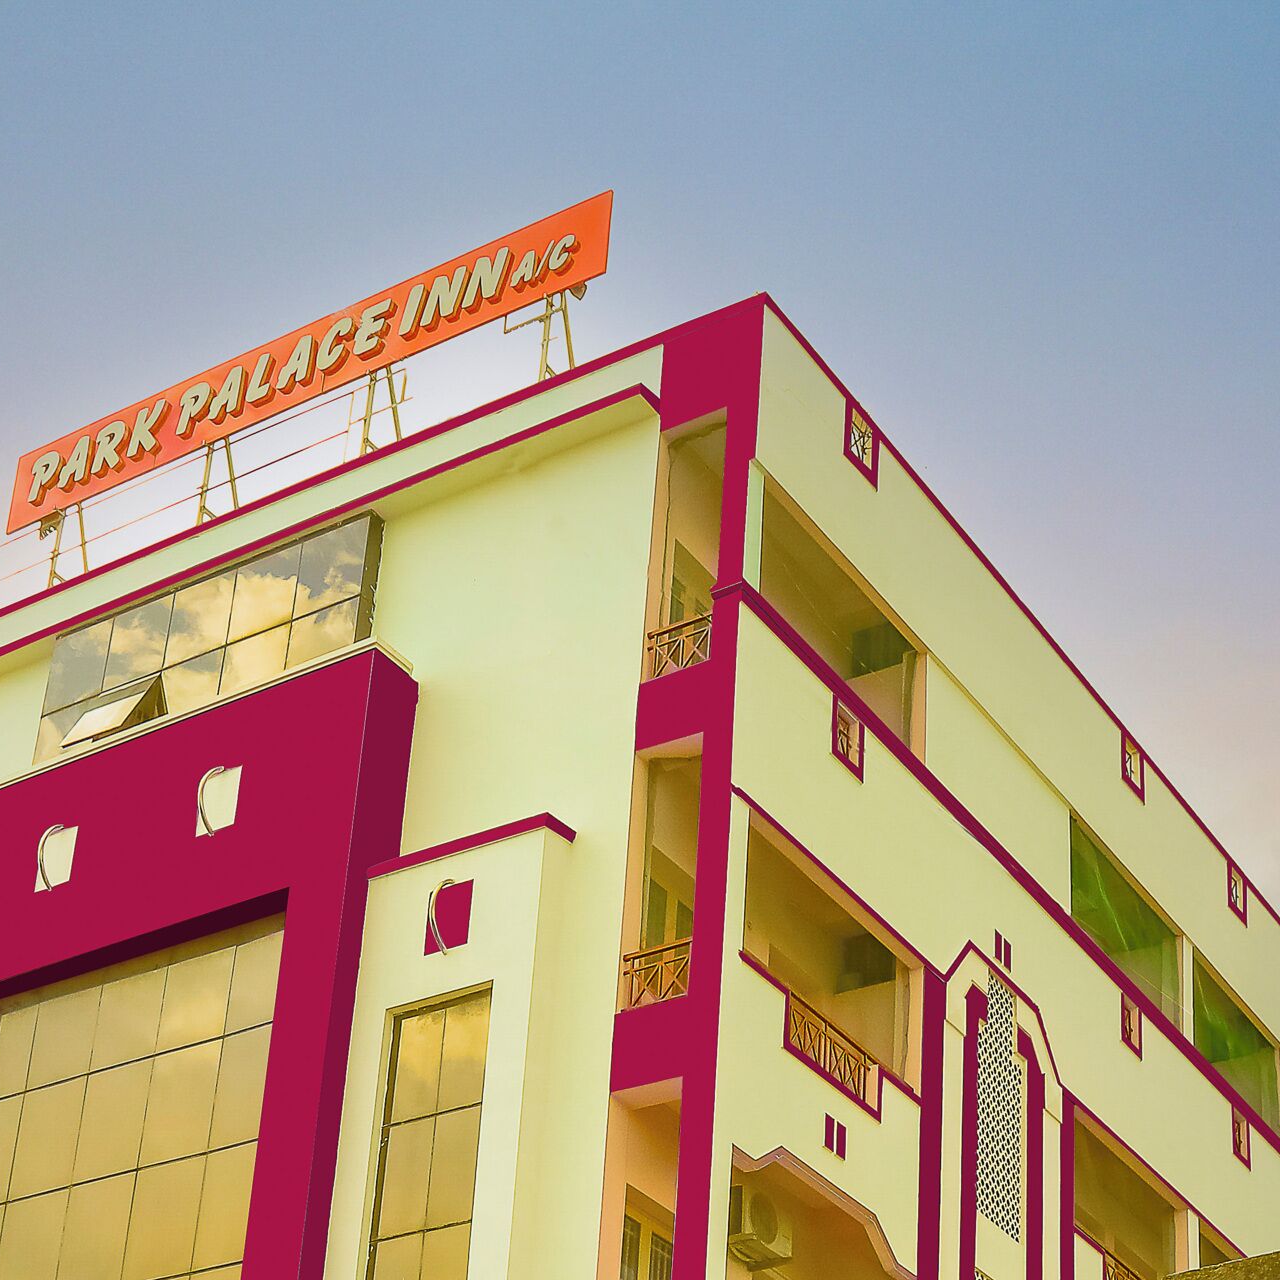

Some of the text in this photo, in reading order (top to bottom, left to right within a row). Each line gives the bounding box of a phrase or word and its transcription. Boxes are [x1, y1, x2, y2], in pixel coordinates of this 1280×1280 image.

[27, 233, 581, 507] PARK PALACE INN A/C
